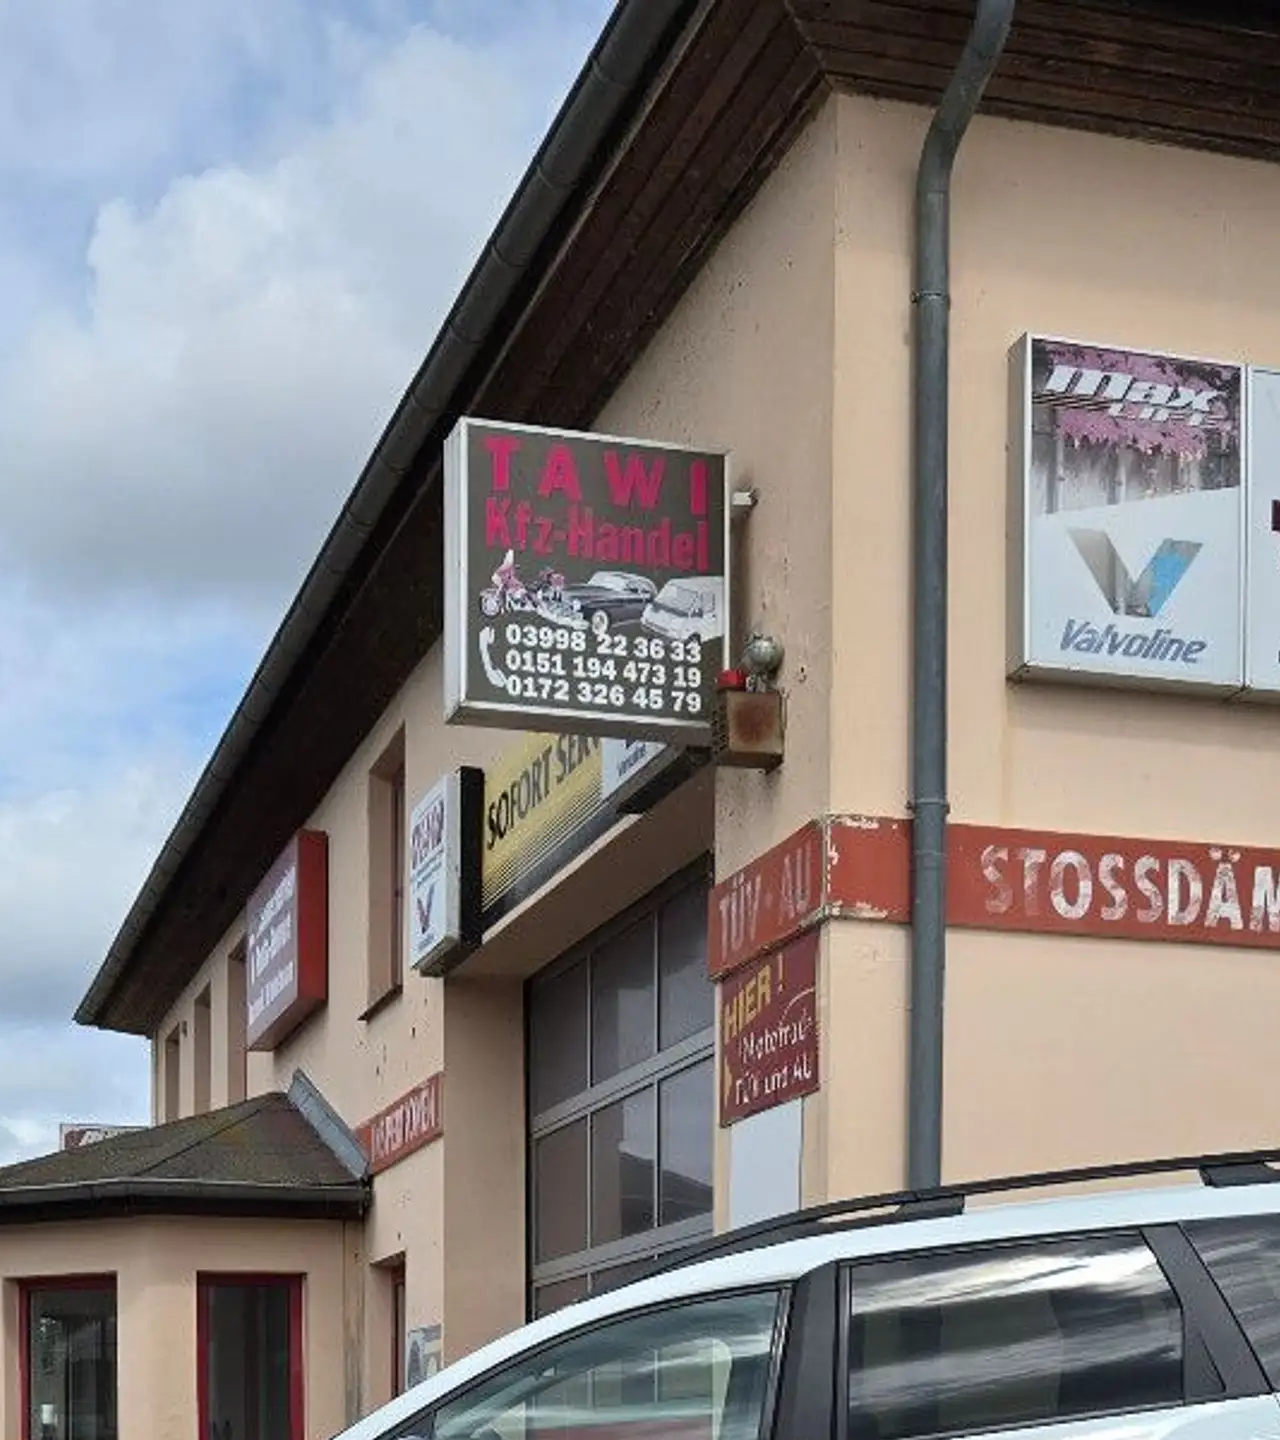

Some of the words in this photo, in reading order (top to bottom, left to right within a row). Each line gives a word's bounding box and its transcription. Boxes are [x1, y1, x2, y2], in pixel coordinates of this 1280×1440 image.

[484, 496, 710, 573] Kfz-Handel
[505, 623, 587, 652] 03998
[596, 633, 628, 657] 22
[632, 636, 666, 660] 36
[669, 640, 702, 664] 33
[1059, 616, 1208, 665] Valvoline
[505, 648, 567, 676] 0151
[572, 655, 618, 681] 194
[622, 660, 666, 685] 473
[672, 666, 702, 689] 19
[506, 674, 570, 702] 0172
[576, 681, 625, 706] 326
[631, 686, 664, 710] 45
[670, 690, 702, 713] 79
[487, 744, 553, 851] SOFORT
[723, 965, 771, 1046] HIER
